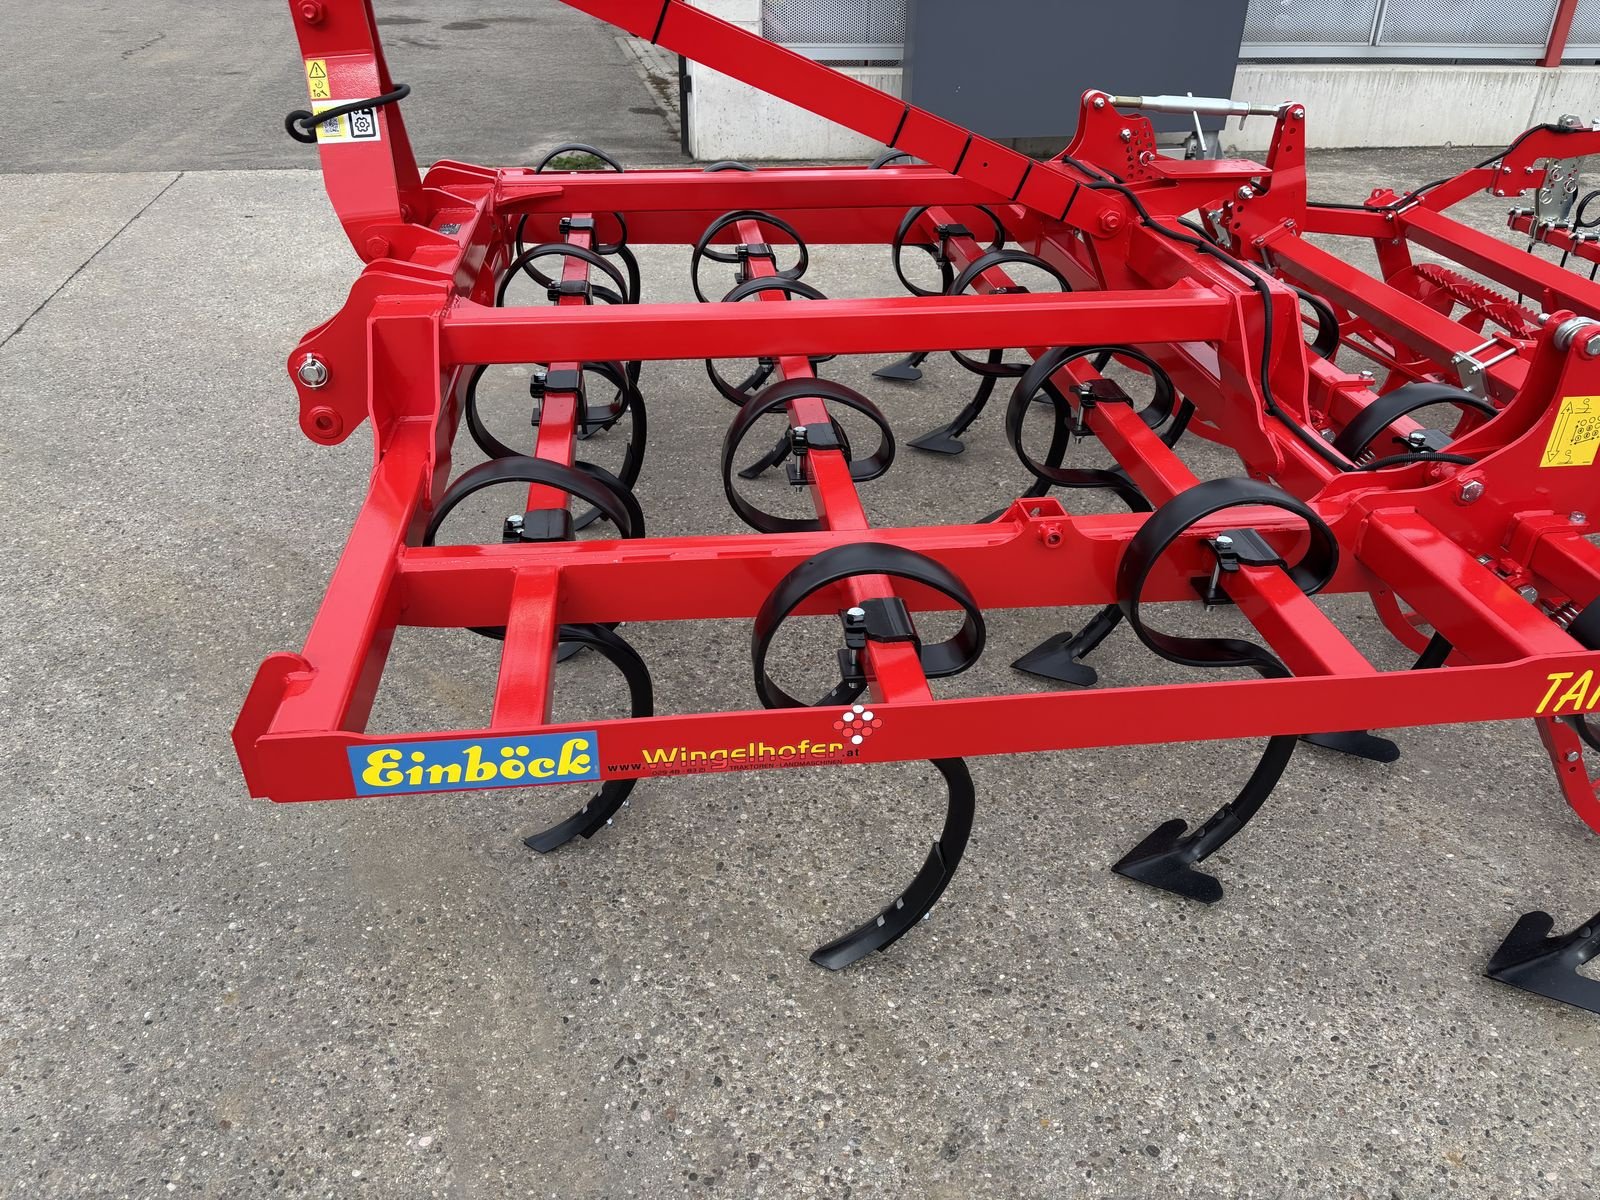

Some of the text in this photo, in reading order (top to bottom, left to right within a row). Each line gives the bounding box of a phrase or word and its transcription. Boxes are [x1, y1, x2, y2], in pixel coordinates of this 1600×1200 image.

[361, 737, 592, 787] Einböck
[729, 763, 774, 771] TRAKTOREN
[779, 759, 843, 768] LANDMASCHINEN
